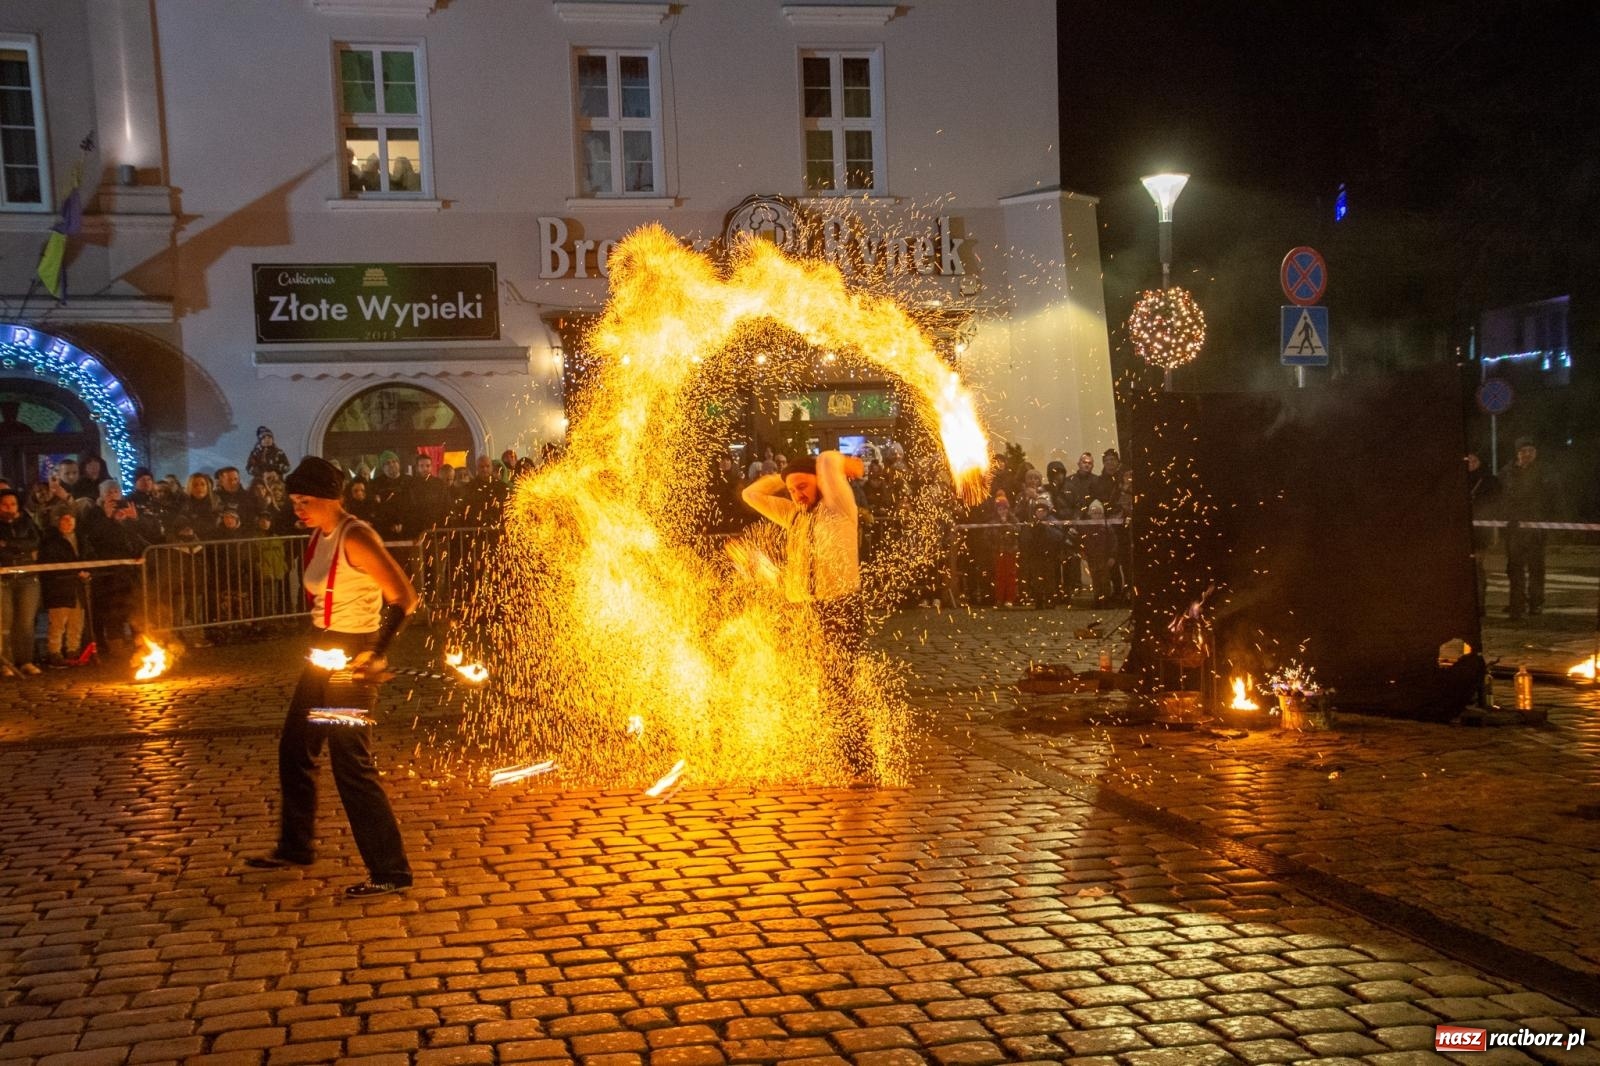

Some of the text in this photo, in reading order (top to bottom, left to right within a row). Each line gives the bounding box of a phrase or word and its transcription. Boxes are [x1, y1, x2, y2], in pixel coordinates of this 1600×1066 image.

[822, 215, 966, 278] Rynek
[277, 271, 336, 287] Cukiernia
[268, 291, 483, 328] Złote Wypieki
